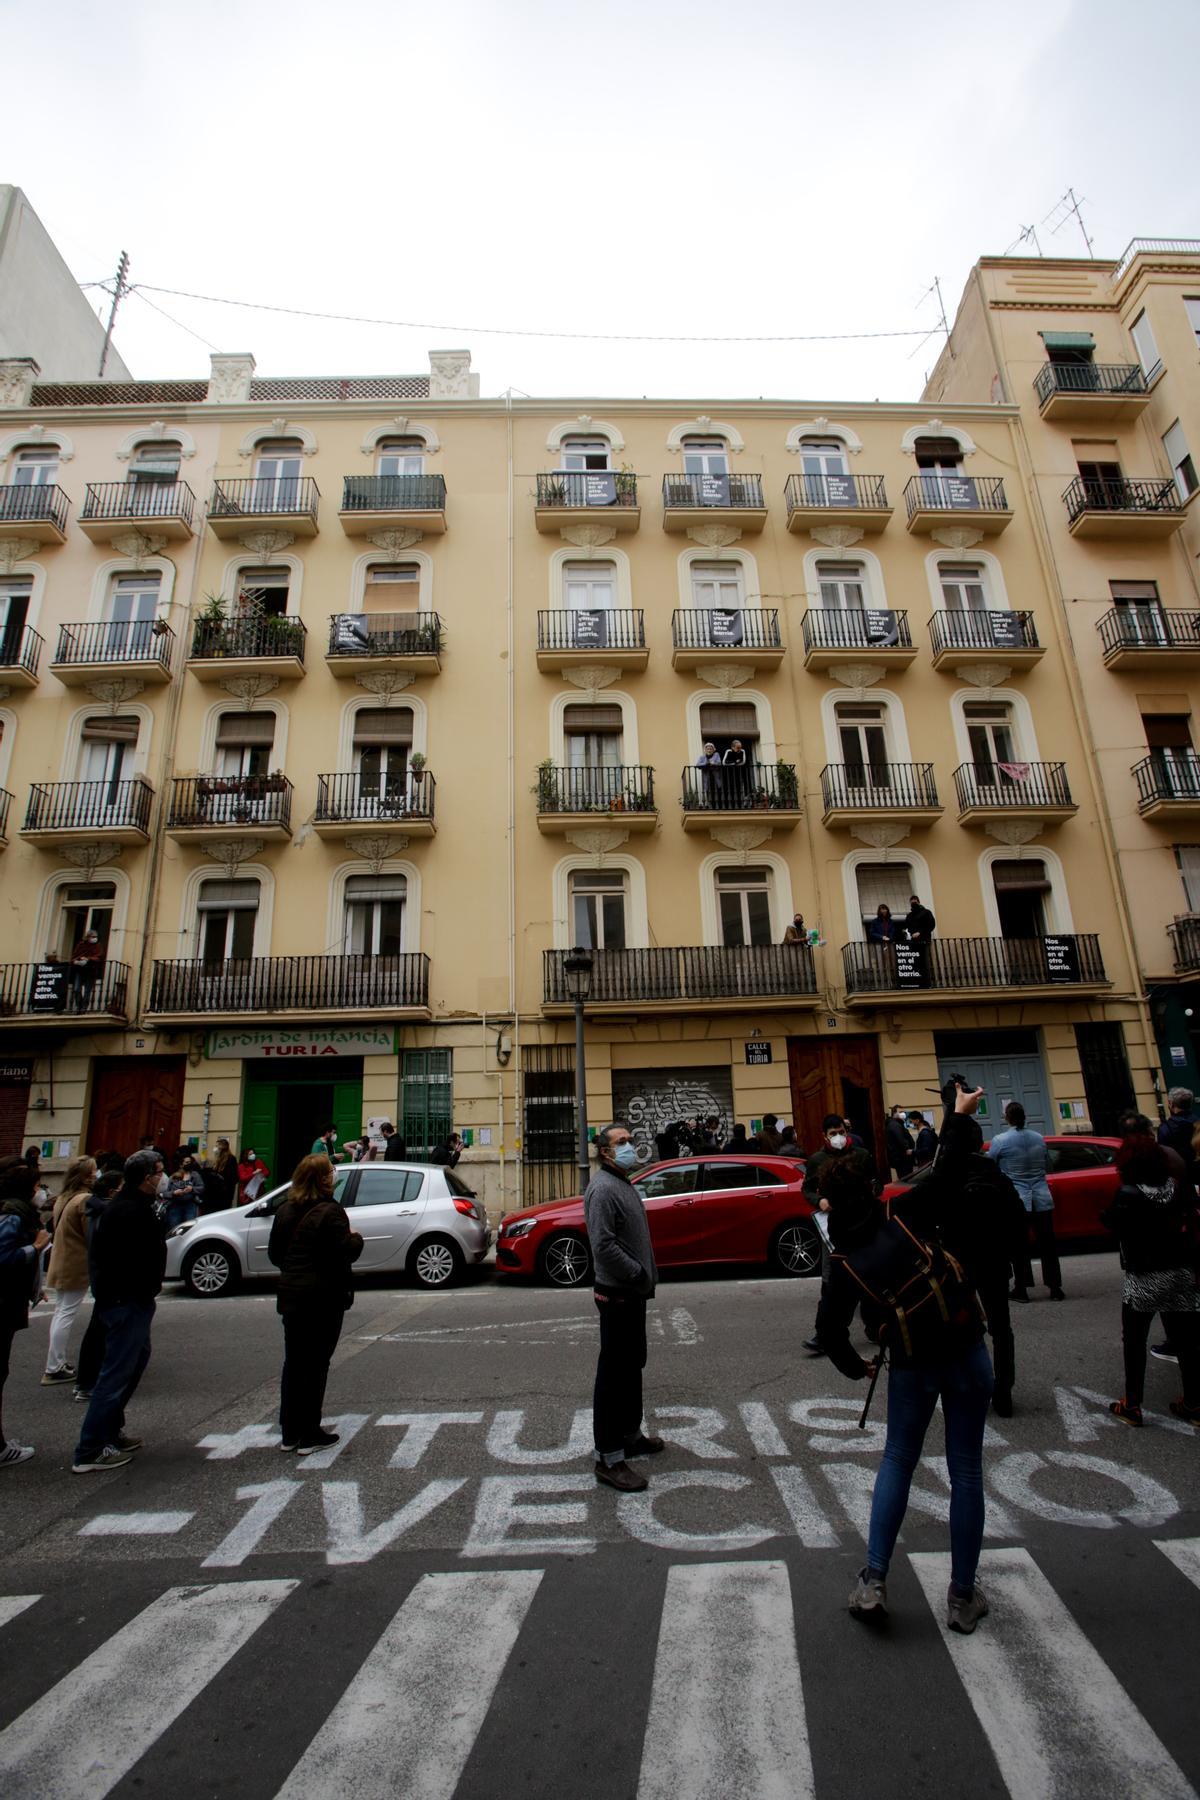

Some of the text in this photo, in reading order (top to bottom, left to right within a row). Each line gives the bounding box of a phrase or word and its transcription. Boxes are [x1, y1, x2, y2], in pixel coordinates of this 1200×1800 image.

[280, 1031, 301, 1043] de
[308, 1028, 391, 1045] infancia
[261, 1045, 338, 1056] TURIA
[749, 1054, 768, 1064] TURIA
[321, 1450, 1181, 1566] VECINO
